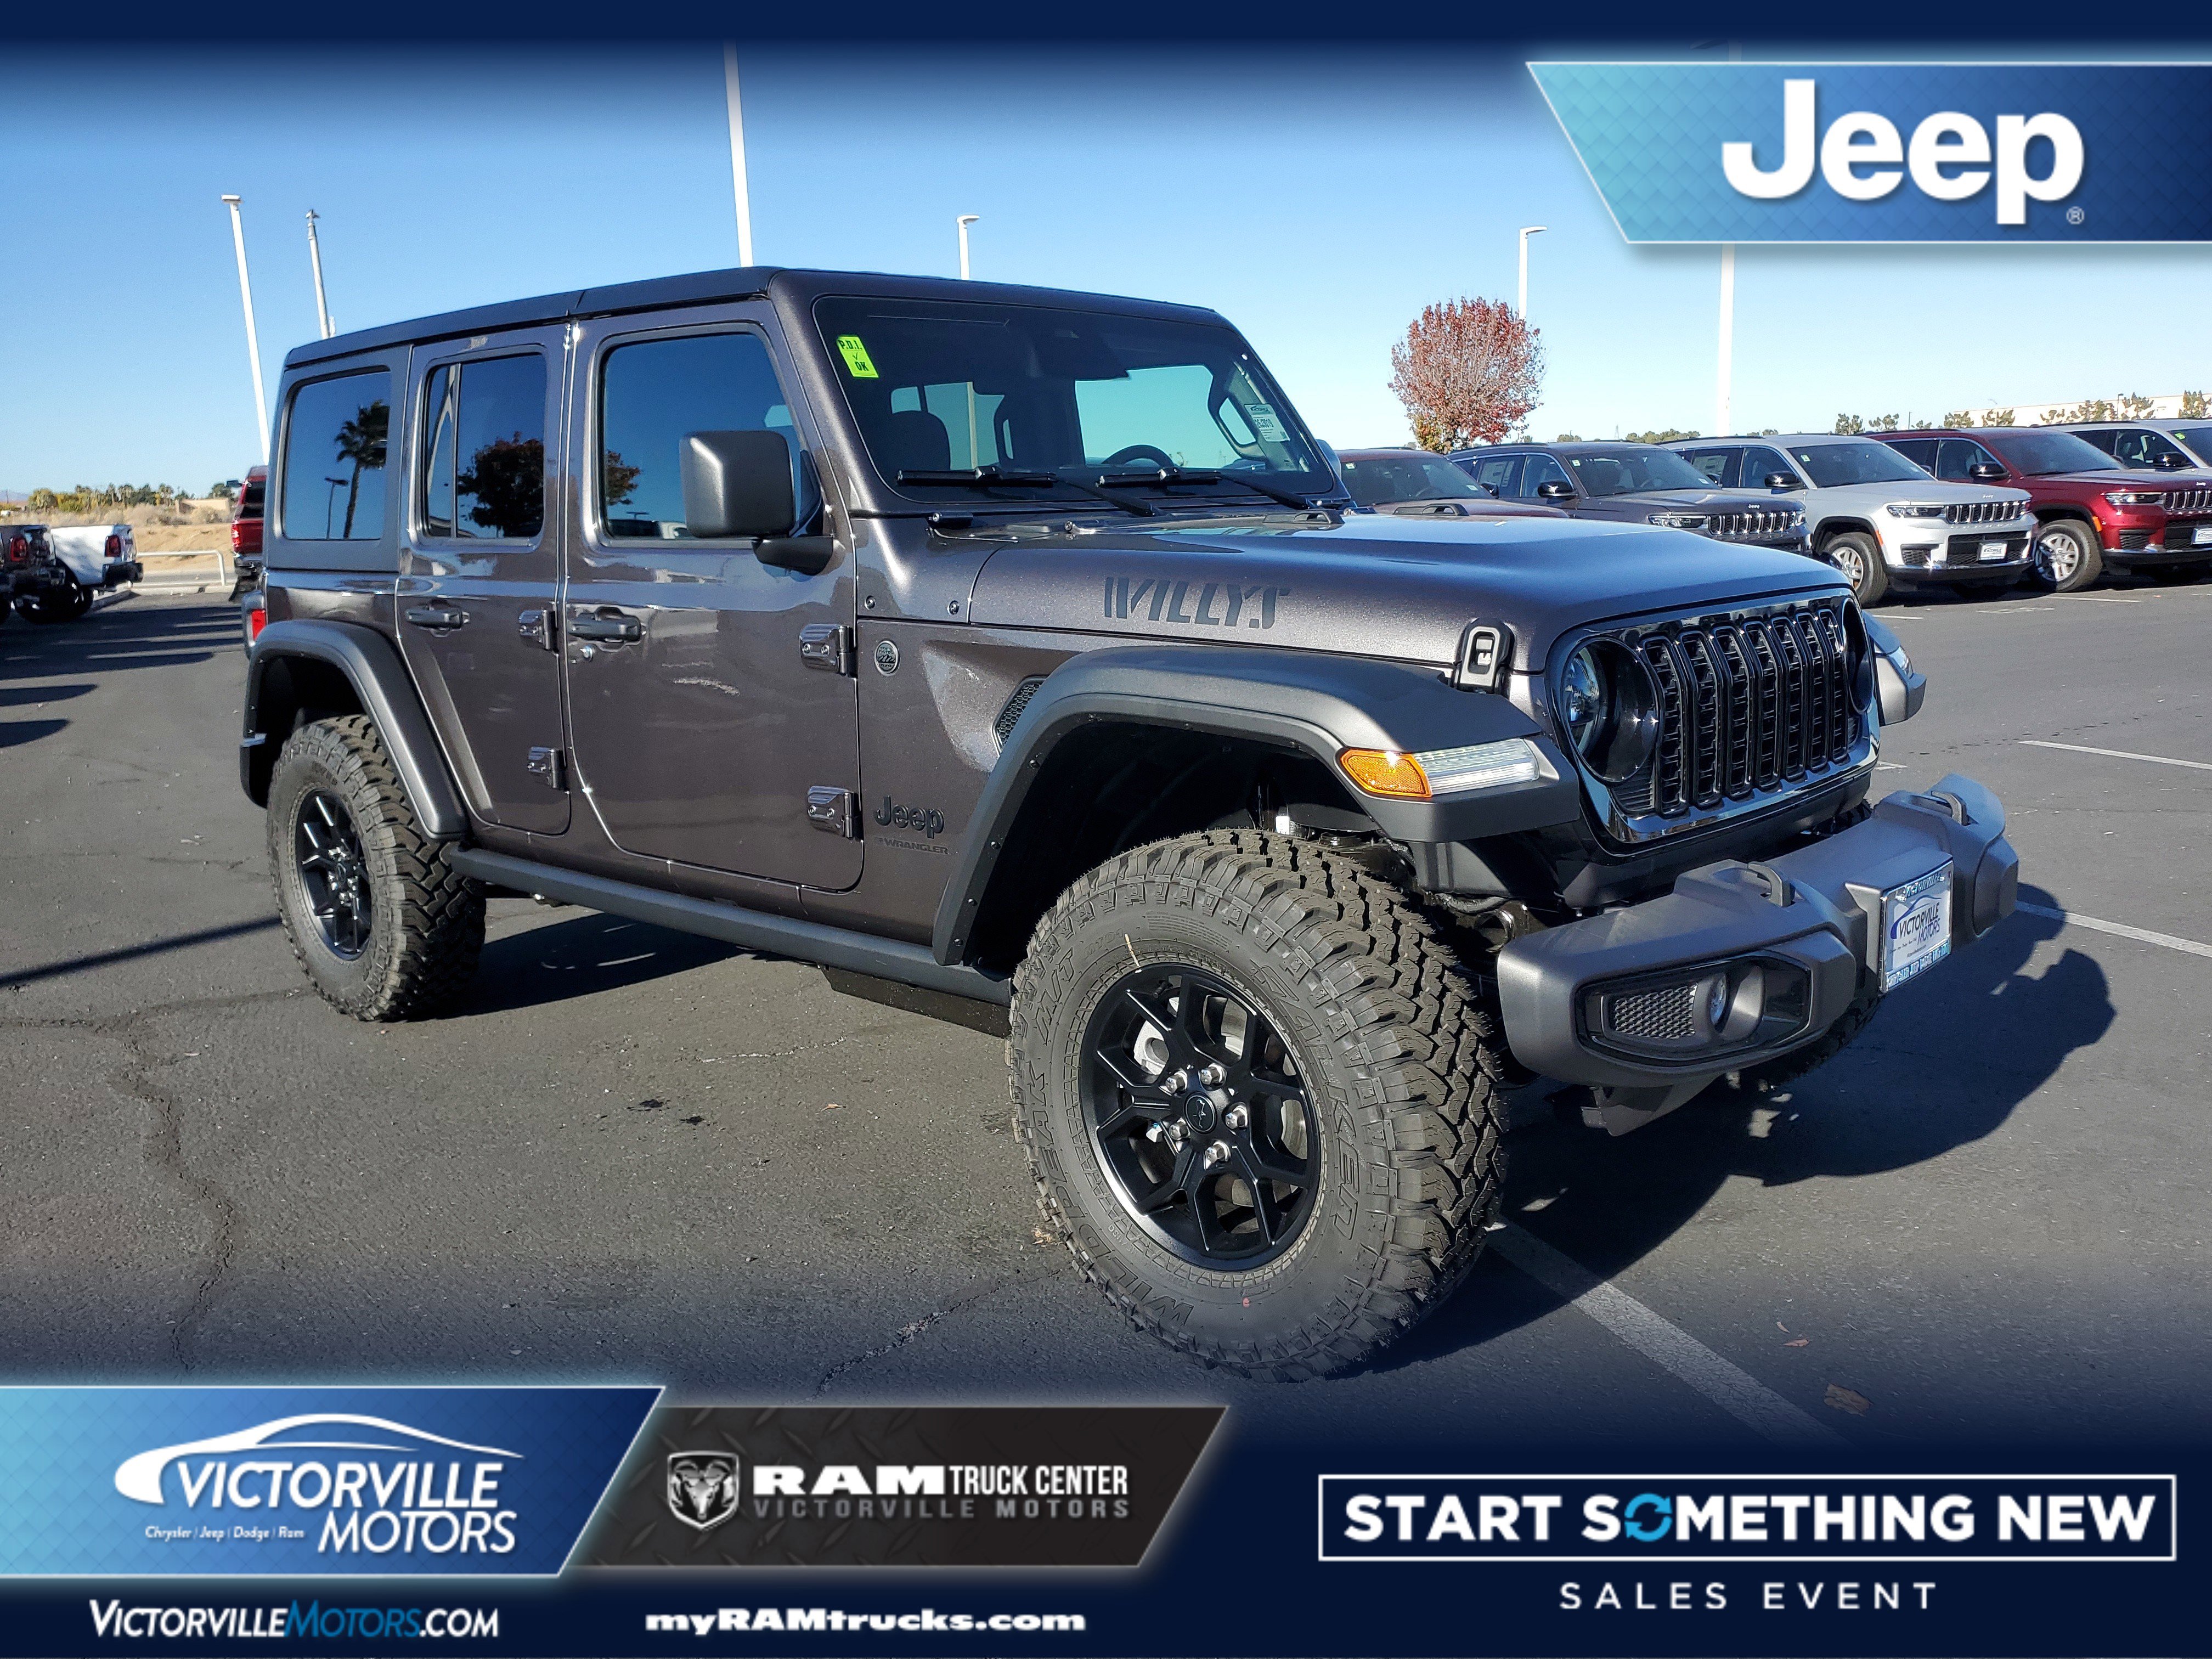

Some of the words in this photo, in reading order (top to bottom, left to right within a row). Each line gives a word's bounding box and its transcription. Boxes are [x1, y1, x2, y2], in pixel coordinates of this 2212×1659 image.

[854, 361, 870, 371] OK
[1104, 577, 1291, 629] WILLYS
[873, 794, 944, 839] Jeep
[883, 838, 950, 855] WRANGLER
[1899, 901, 1940, 939] VICTORVILLE
[1917, 917, 1940, 946] MOTORS
